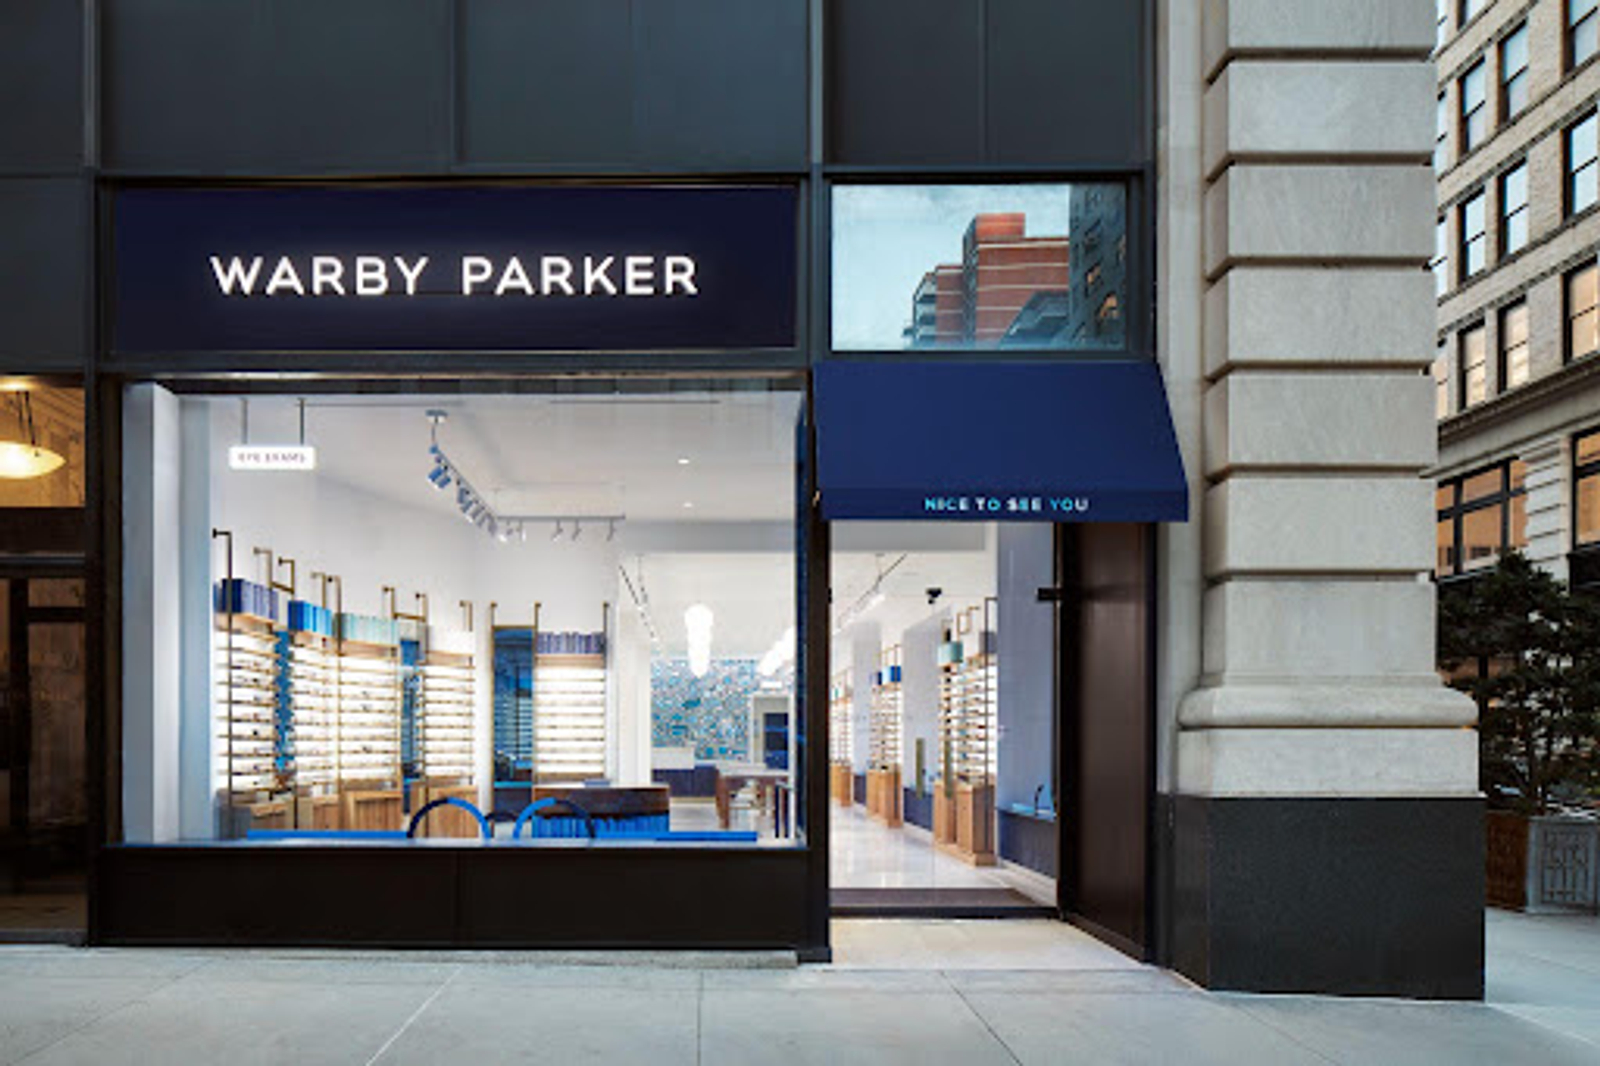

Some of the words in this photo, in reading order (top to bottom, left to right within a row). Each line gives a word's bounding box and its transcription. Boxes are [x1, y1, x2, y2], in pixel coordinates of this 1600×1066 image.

[210, 255, 427, 295] WARBY
[461, 255, 698, 295] PARKER
[924, 496, 970, 511] NICE
[975, 496, 1001, 511] TO
[1006, 496, 1042, 511] SEE
[1050, 497, 1089, 511] YOU
